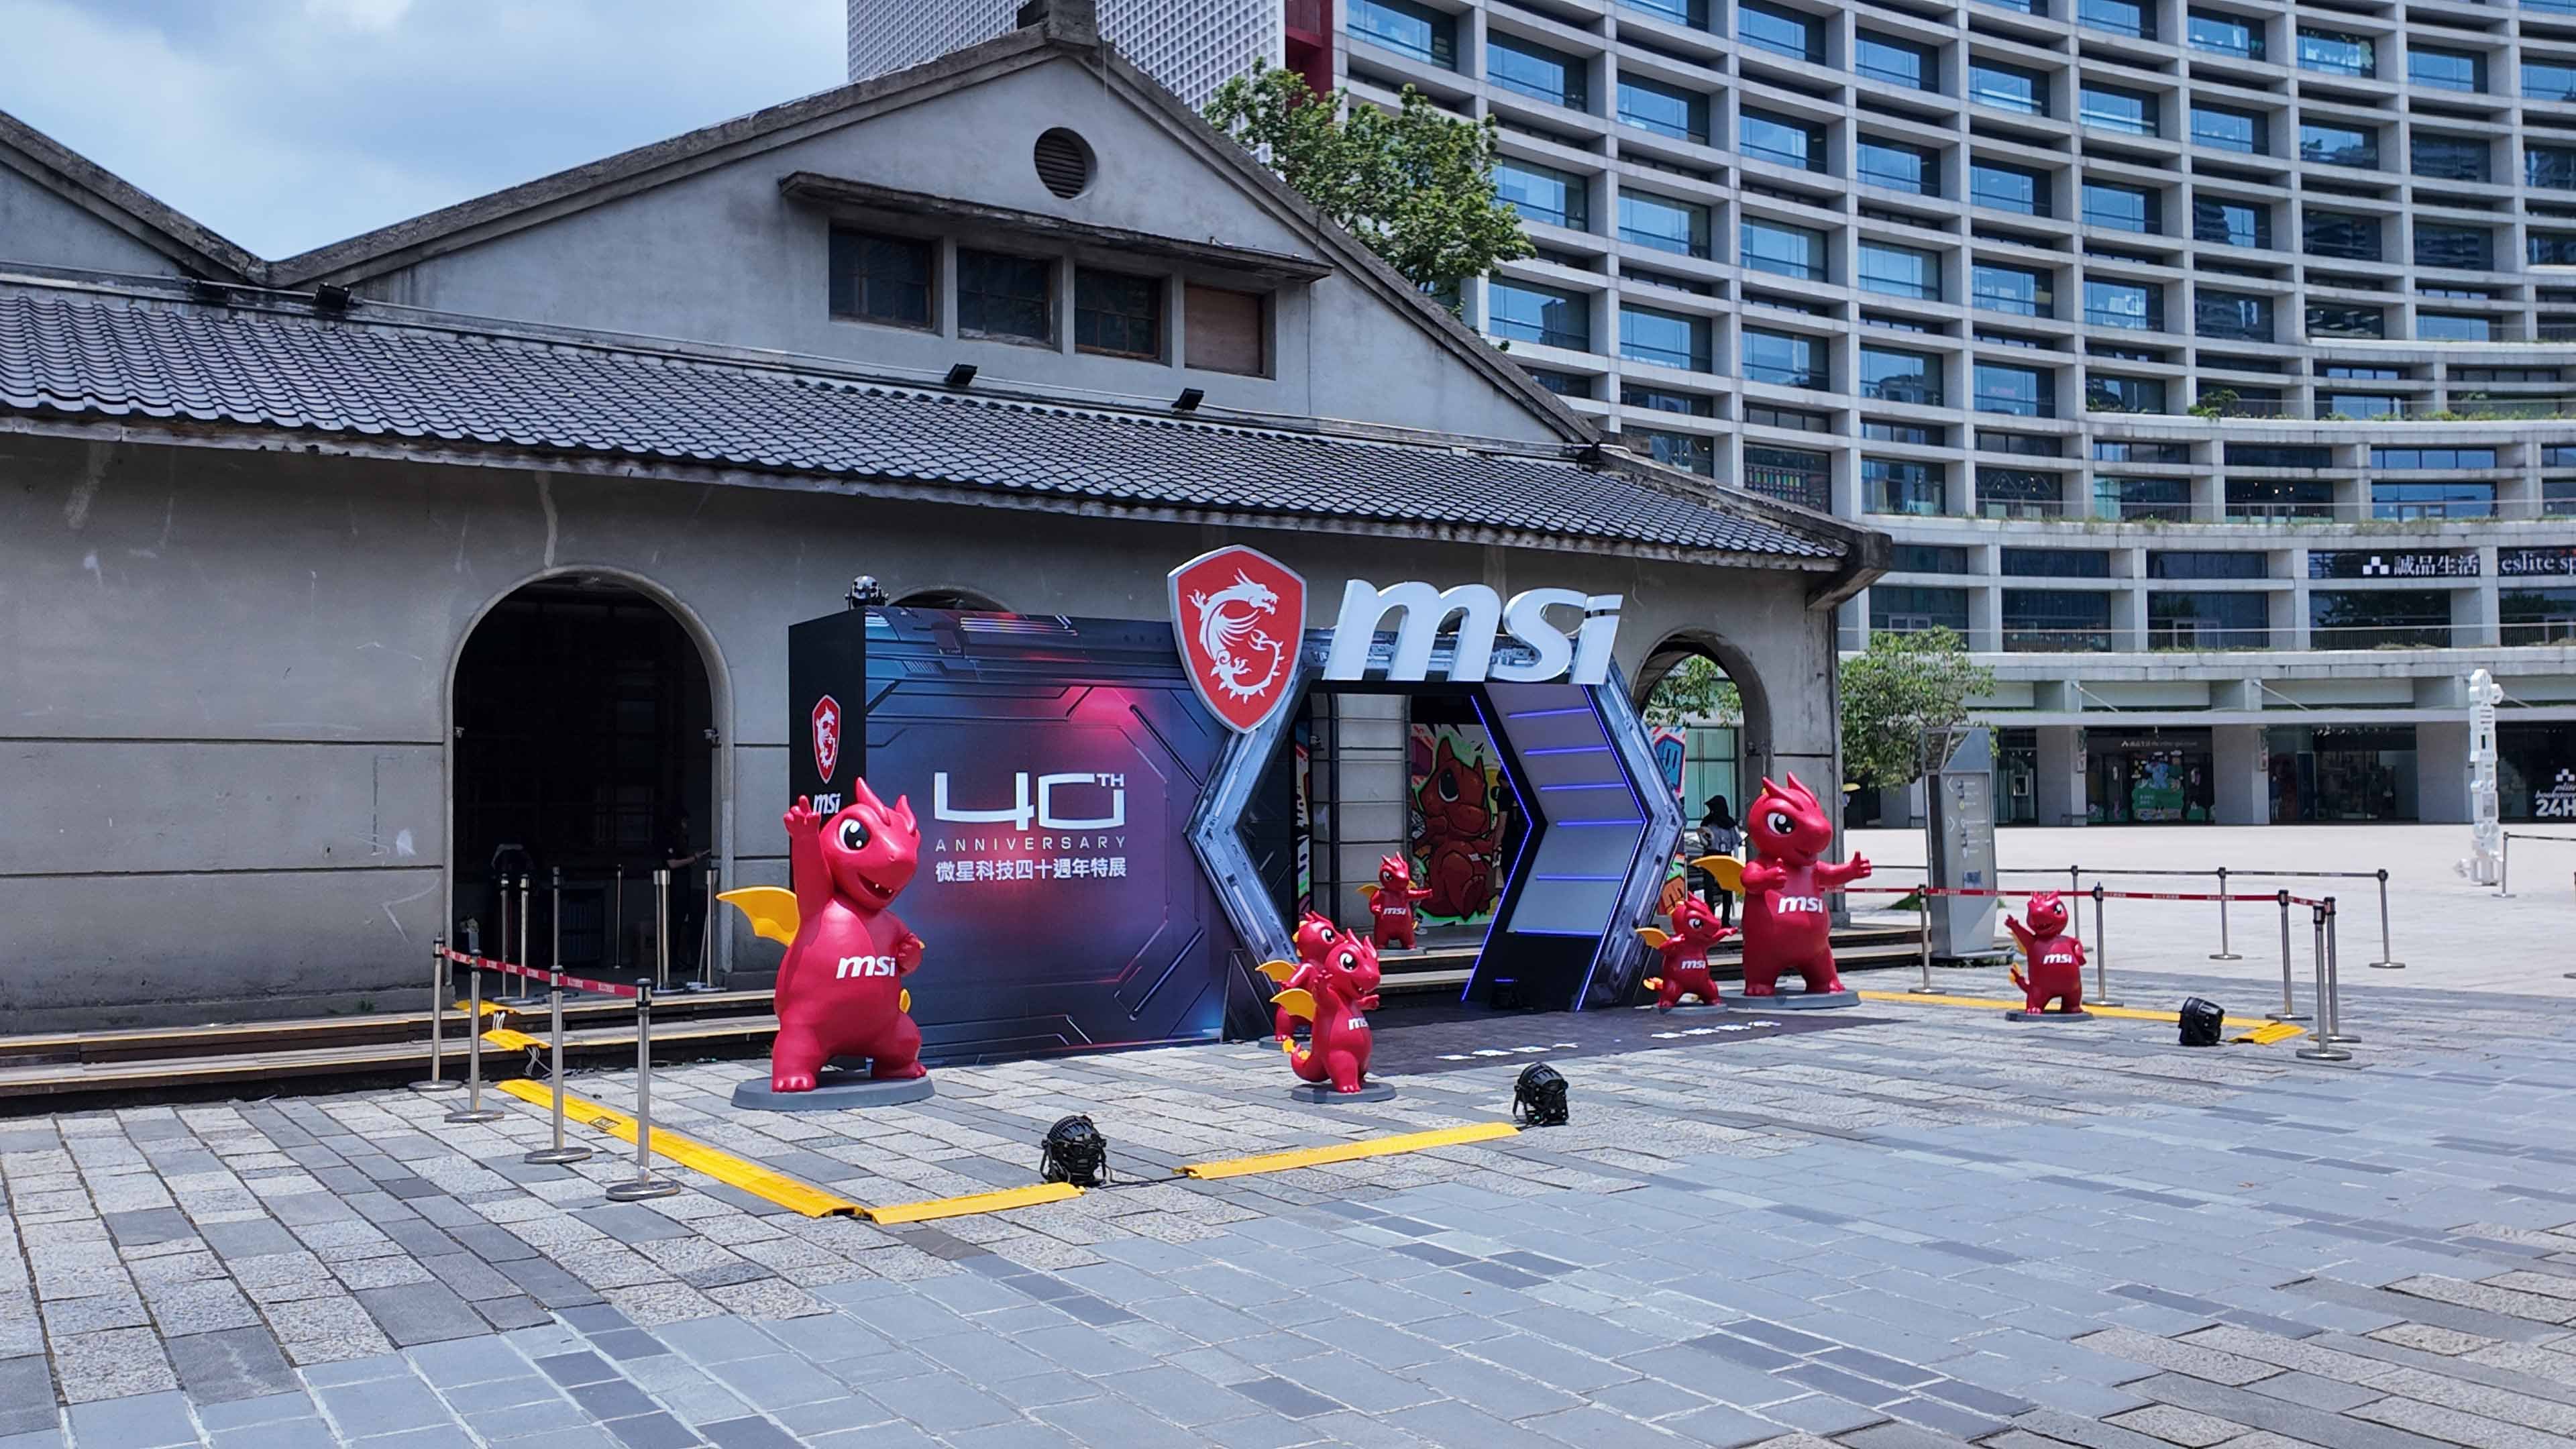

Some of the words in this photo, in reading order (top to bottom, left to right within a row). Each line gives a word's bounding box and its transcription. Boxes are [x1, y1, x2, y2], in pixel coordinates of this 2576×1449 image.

[2394, 554, 2480, 576] 誠品生活
[2502, 553, 2555, 571] eslite
[1321, 579, 1624, 685] msi
[814, 793, 841, 814] msi
[935, 837, 1125, 852] ANNIVERSARY
[935, 857, 1126, 882] 微星科技四十週年特展
[1383, 907, 1407, 915] msi
[1778, 896, 1823, 914] msi
[836, 955, 896, 979] msi
[1681, 960, 1706, 969] msi
[2043, 954, 2072, 965] msi
